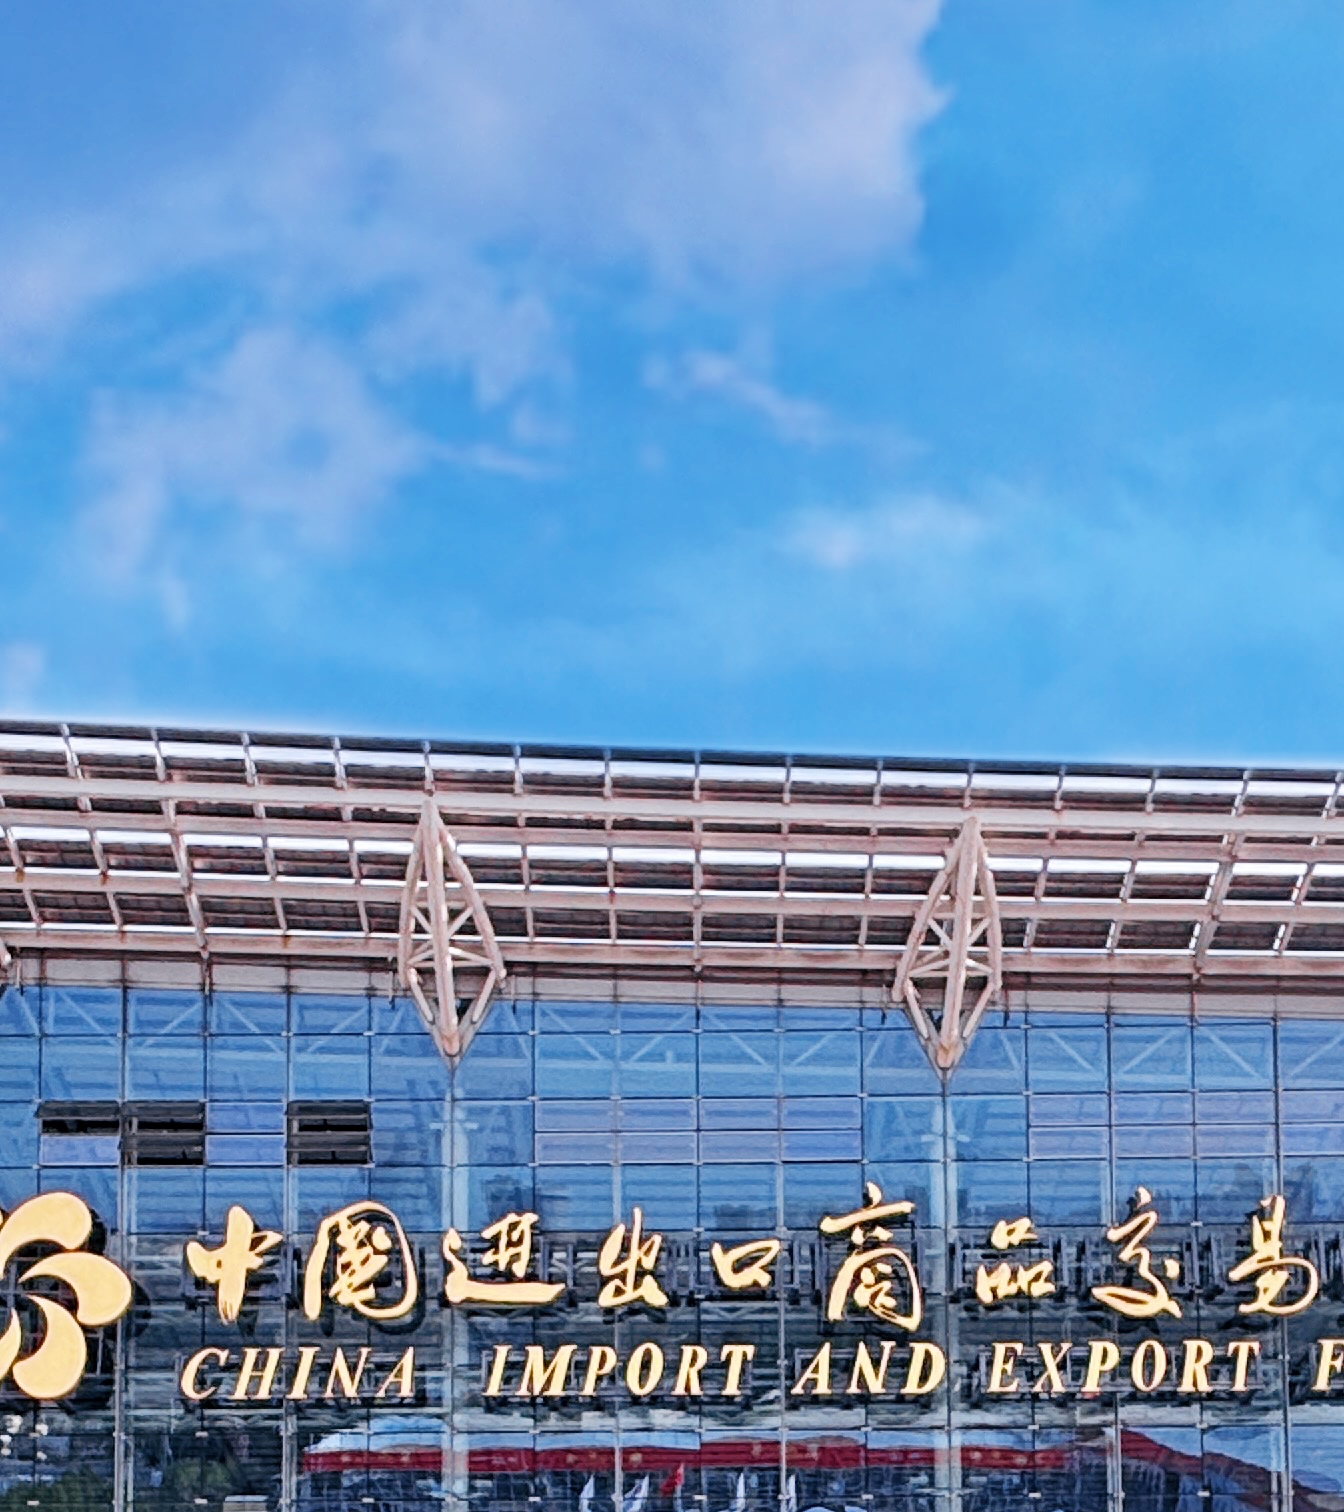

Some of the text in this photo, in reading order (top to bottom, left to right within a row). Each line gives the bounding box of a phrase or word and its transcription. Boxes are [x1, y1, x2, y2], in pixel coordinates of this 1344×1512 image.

[180, 1347, 417, 1400] CHINA
[484, 1343, 755, 1398] IMPORT
[792, 1341, 946, 1395] AND
[987, 1339, 1260, 1393] EXPORT
